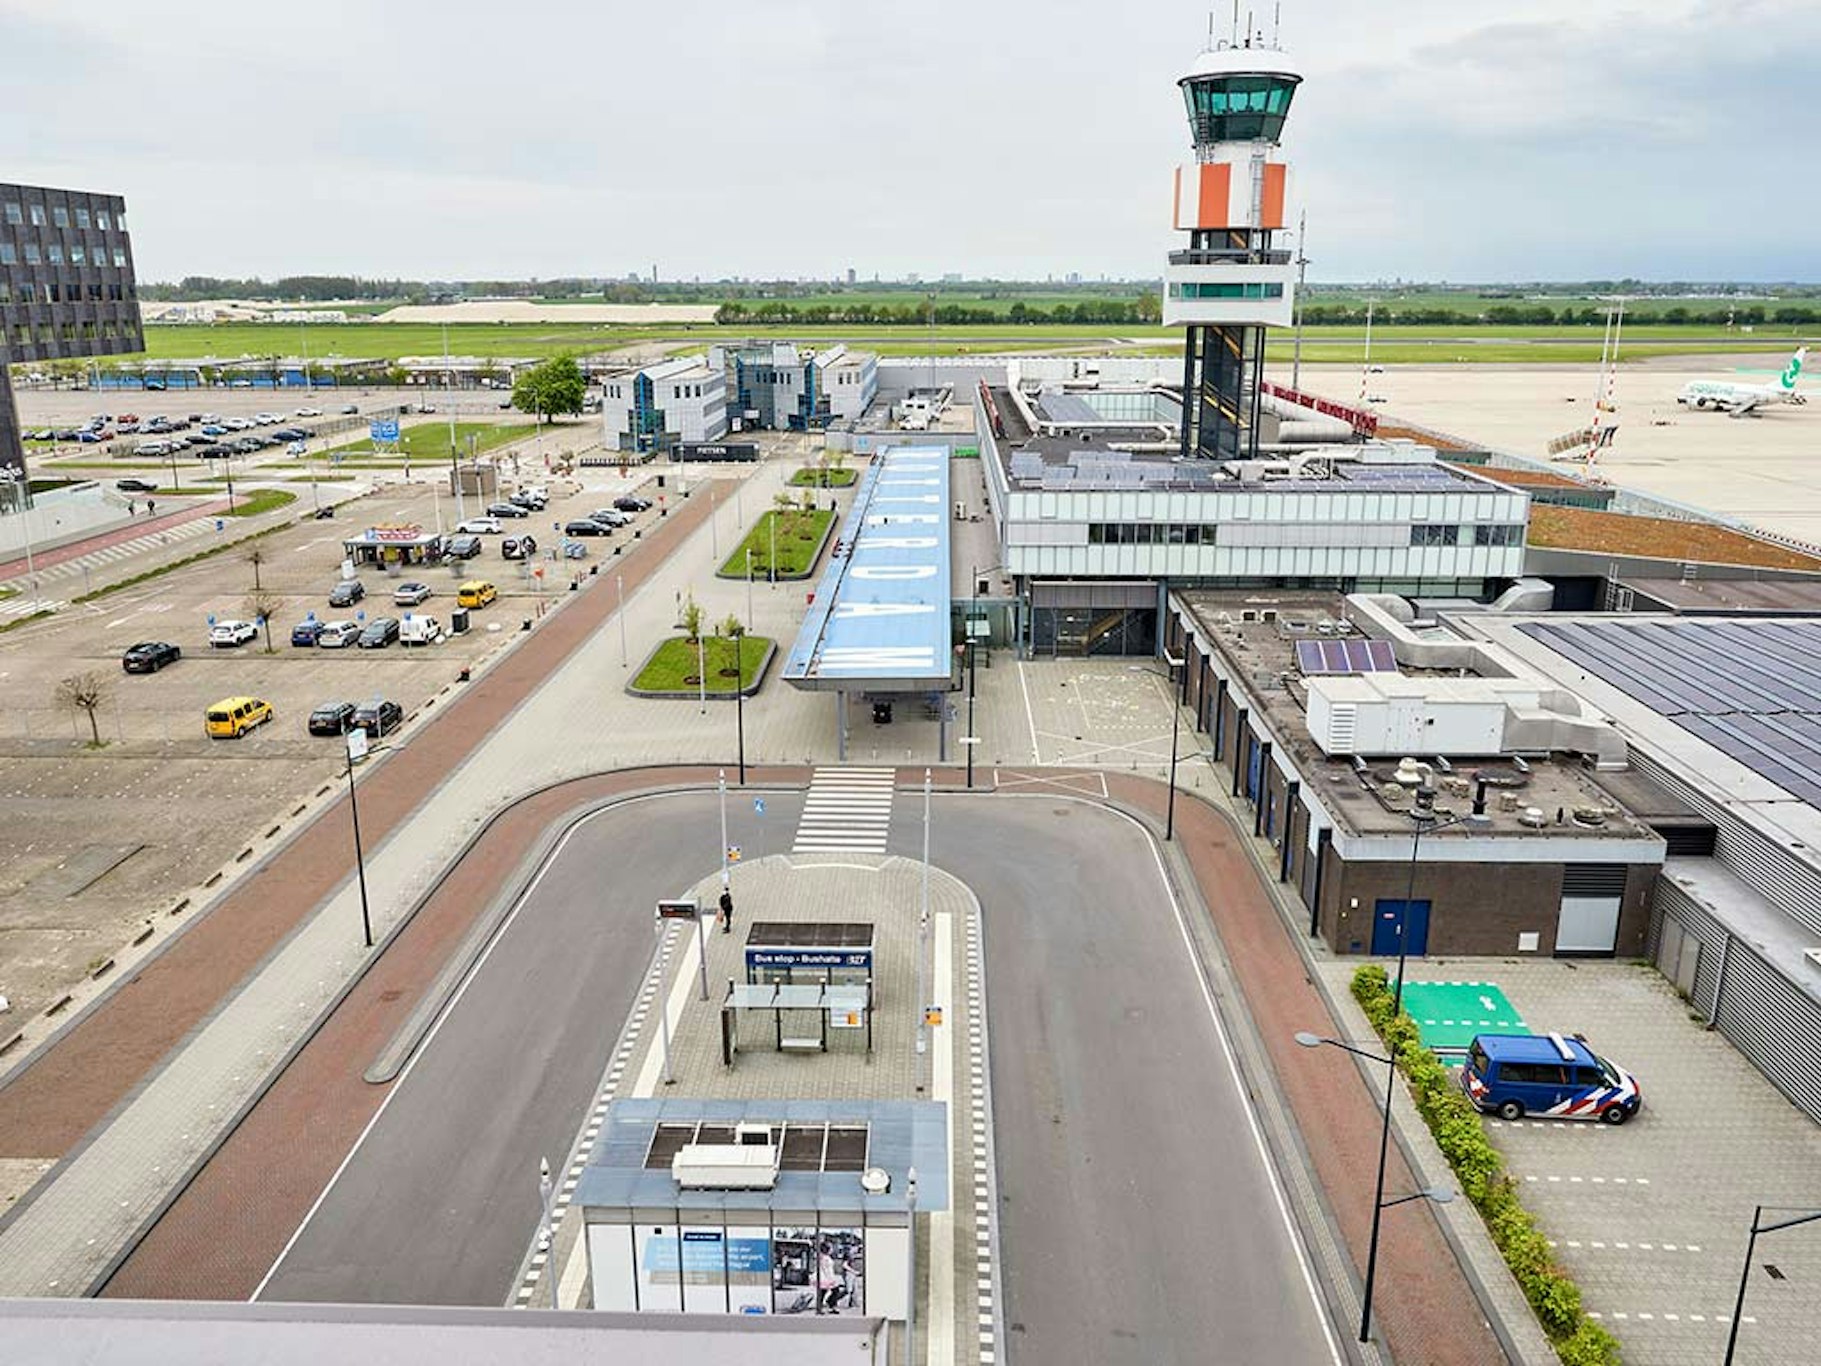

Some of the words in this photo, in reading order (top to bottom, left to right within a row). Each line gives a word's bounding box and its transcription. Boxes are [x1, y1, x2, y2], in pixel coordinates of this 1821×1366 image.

[818, 451, 942, 668] ROTTERDAM
[754, 954, 773, 963] Bus
[774, 954, 795, 964] stop
[801, 954, 842, 963] Bushalte
